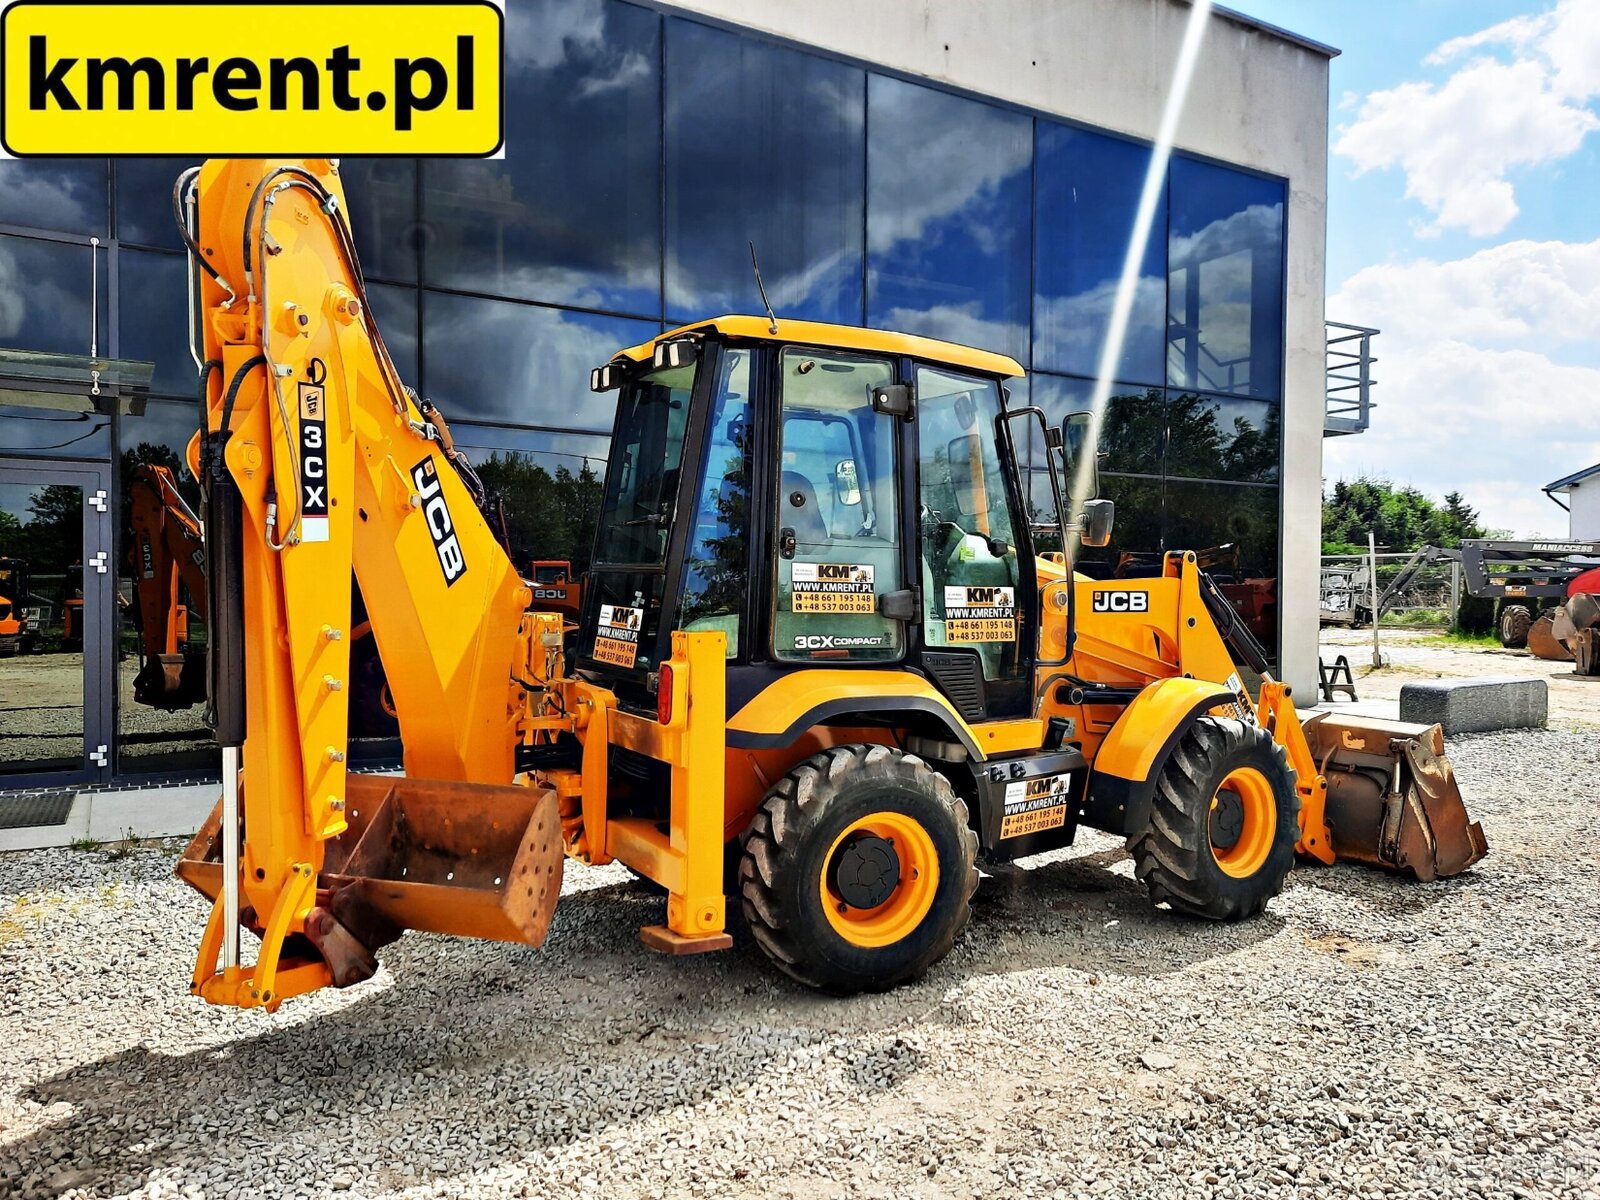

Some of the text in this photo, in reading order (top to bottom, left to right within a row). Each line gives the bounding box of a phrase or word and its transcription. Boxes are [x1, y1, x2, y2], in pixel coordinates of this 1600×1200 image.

[306, 392, 318, 416] JCB
[304, 425, 325, 508] 3CX
[414, 466, 463, 580] JCB
[818, 565, 850, 578] KM
[793, 583, 873, 592] WWW.KMRENT.PL
[966, 588, 994, 602] KM
[1094, 592, 1147, 611] JCB
[612, 608, 630, 623] KM
[946, 608, 1014, 618] WWW.KMRENT.PL
[598, 626, 638, 642] WWW.KMRENT.PL
[1000, 631, 1013, 639] 063
[794, 636, 834, 649] 3CX
[1026, 778, 1052, 796] KM
[1004, 795, 1067, 816] WWW.KMRENT.PL
[1026, 813, 1037, 821] 661
[1039, 810, 1050, 819] 195
[1052, 807, 1064, 815] 148
[1010, 817, 1062, 834] +48 537 003 063
